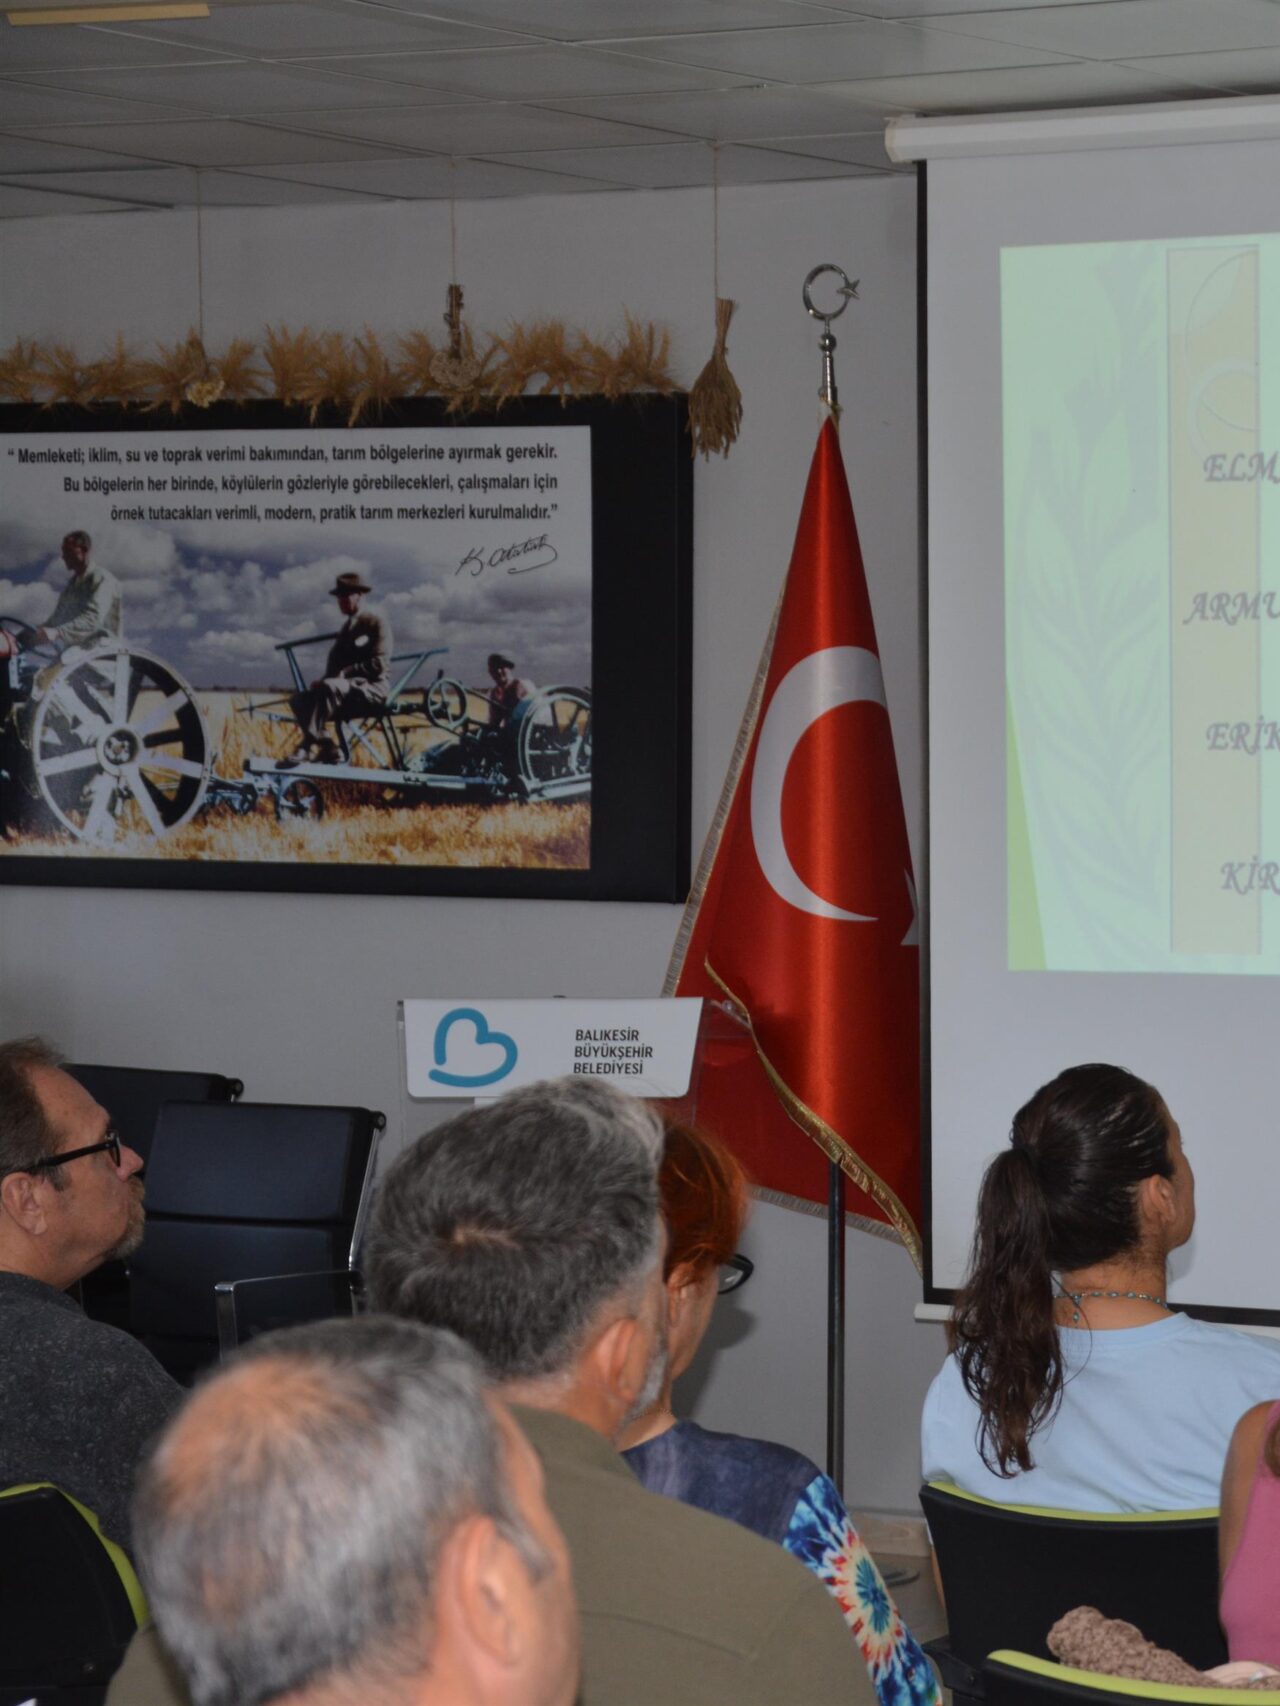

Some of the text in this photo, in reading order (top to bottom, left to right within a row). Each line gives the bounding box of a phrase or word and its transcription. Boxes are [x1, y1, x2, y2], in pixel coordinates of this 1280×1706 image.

[88, 447, 122, 464] iklim,
[126, 449, 141, 462] su
[144, 449, 159, 462] ve
[162, 446, 202, 465] toprak
[206, 446, 246, 461] verimi
[249, 444, 328, 463] bakımından,
[332, 445, 366, 460] tarım
[370, 444, 445, 463] bölgelerine
[448, 443, 502, 463] ayırmak
[505, 442, 558, 462] gerekir.
[63, 472, 558, 495] Bu bölgelerin her birinde, köylülerin gözleriyle görebilecekleri, çalışmaları için
[110, 504, 145, 521] örnek
[148, 503, 212, 520] tutacakları
[215, 503, 261, 522] verimli,
[264, 502, 316, 522] modern,
[319, 502, 357, 523] pratik
[360, 502, 394, 519] tarım
[397, 502, 465, 519] merkezleri
[575, 1026, 640, 1041] BALIKESİR
[574, 1043, 653, 1060] BÜYÜKŞEHİR
[573, 1060, 644, 1074] BELEDİYESİ
